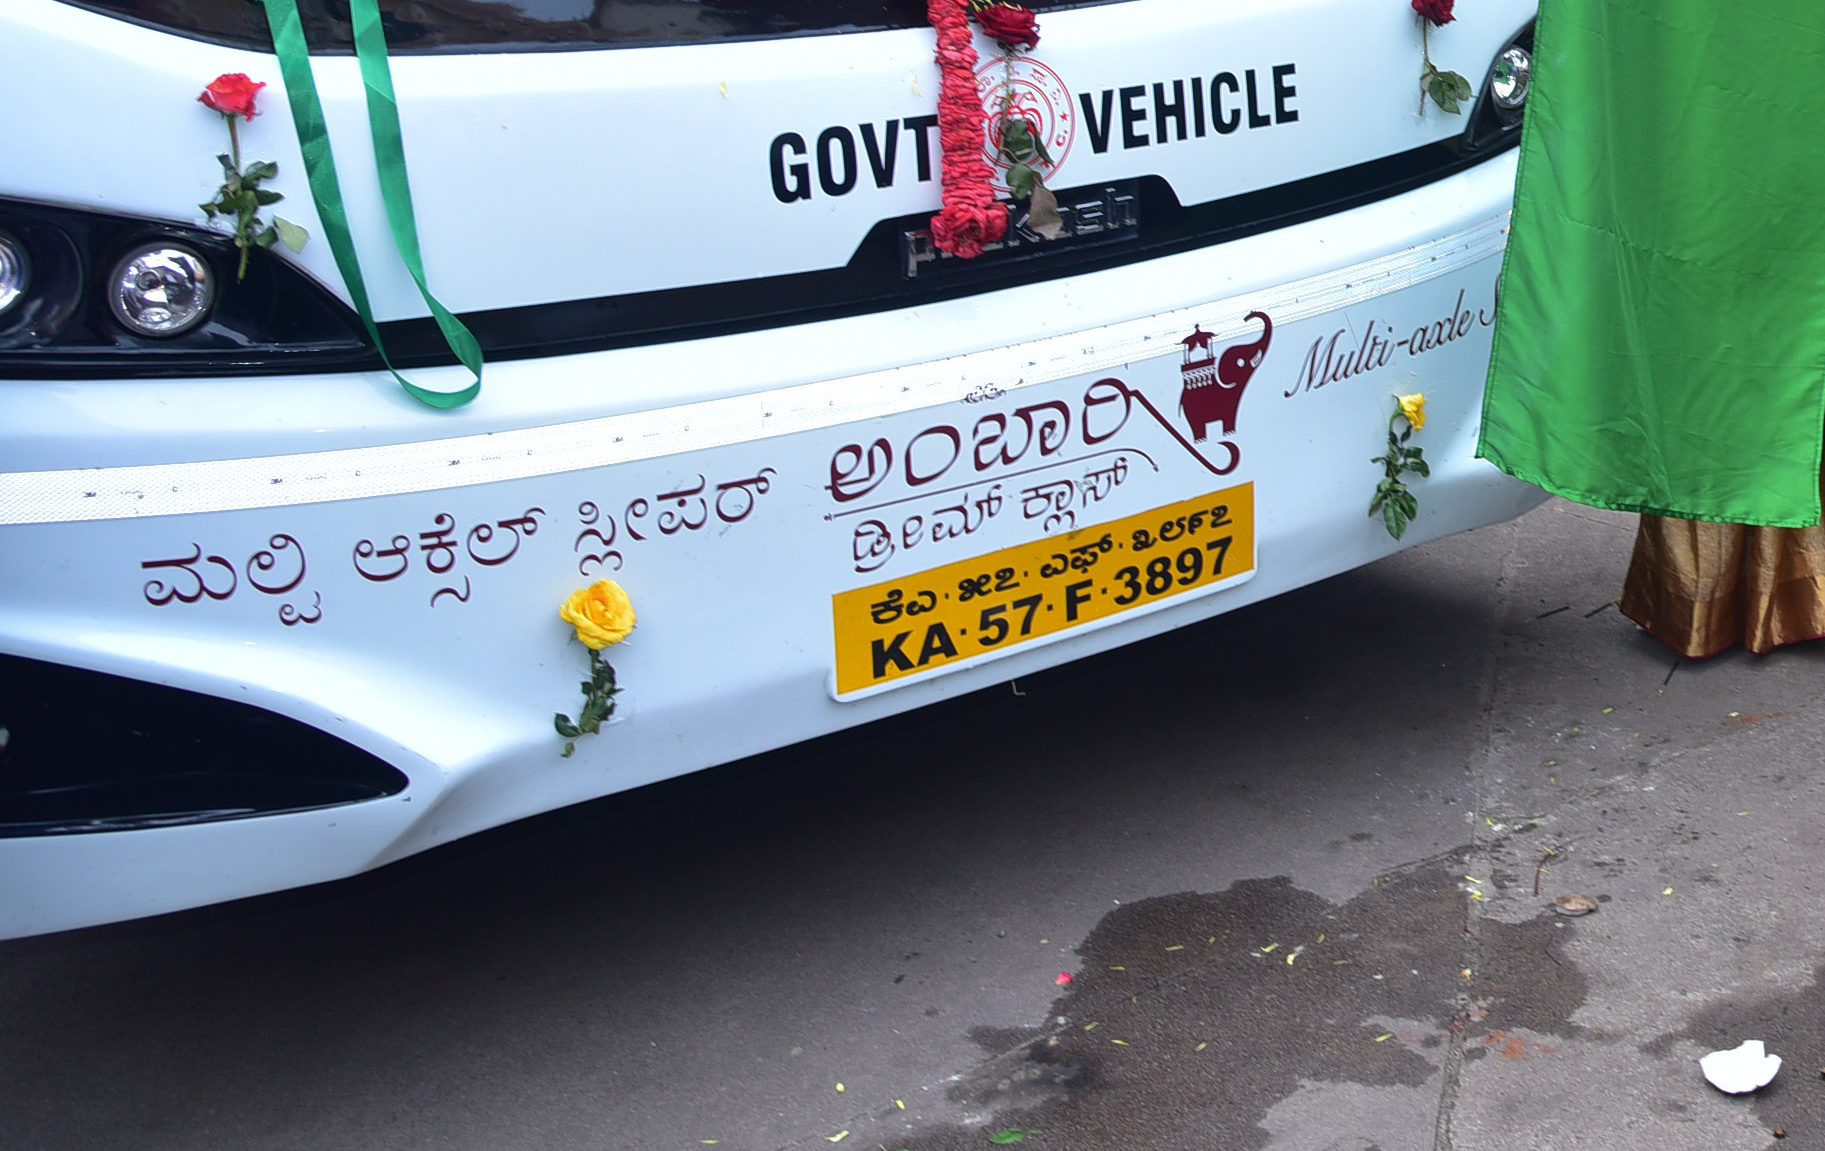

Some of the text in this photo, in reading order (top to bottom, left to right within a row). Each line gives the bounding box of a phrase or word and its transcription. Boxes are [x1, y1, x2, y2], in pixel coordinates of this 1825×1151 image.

[1079, 63, 1299, 154] VEHICLE
[1284, 288, 1476, 398] Multi-axle
[824, 378, 1135, 503] ಅಂಬಾರಿ
[141, 466, 778, 627] ಮಲ್ಟಿ ಆಕ್ಸೆಲ್ ಸ್ಲೀಪರ್
[852, 457, 1128, 573] ಡ್ರೀಮ್ ಕ್ಲಾಸ್
[1114, 535, 1234, 606] 3897
